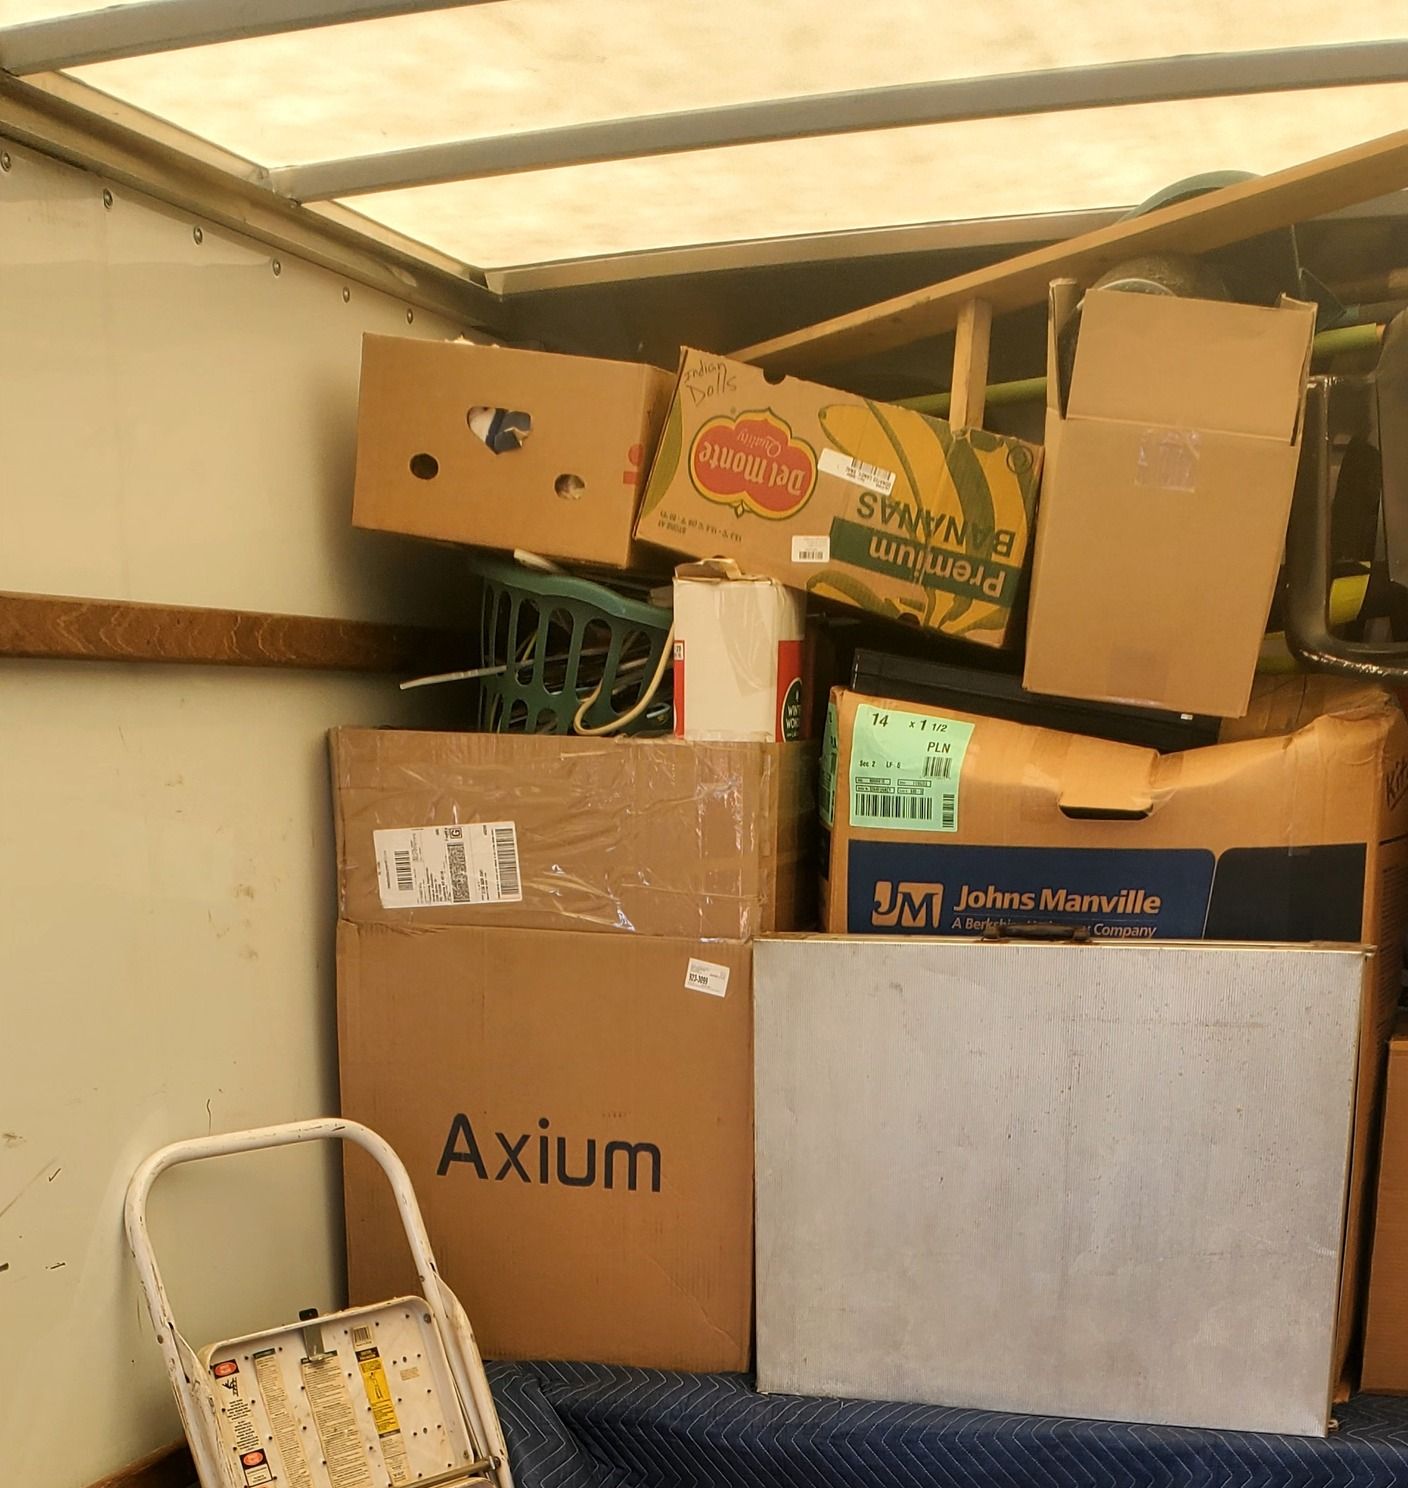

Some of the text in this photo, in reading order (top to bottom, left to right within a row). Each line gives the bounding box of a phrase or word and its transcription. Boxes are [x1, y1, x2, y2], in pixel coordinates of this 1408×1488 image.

[686, 373, 737, 407] Dolls
[736, 427, 783, 458] Quality
[698, 440, 766, 486] Monte
[767, 464, 807, 497] Del
[857, 491, 1016, 558] BANANAS
[868, 534, 1008, 598] Premium
[872, 713, 889, 728] 14
[919, 719, 927, 731] 1
[932, 723, 949, 733] 1/2
[927, 741, 951, 754] PLN
[872, 881, 943, 929] JM
[953, 884, 1162, 915] Johns Manville
[951, 918, 962, 930] A
[1093, 922, 1158, 939] Company
[436, 1111, 663, 1193] Axium
